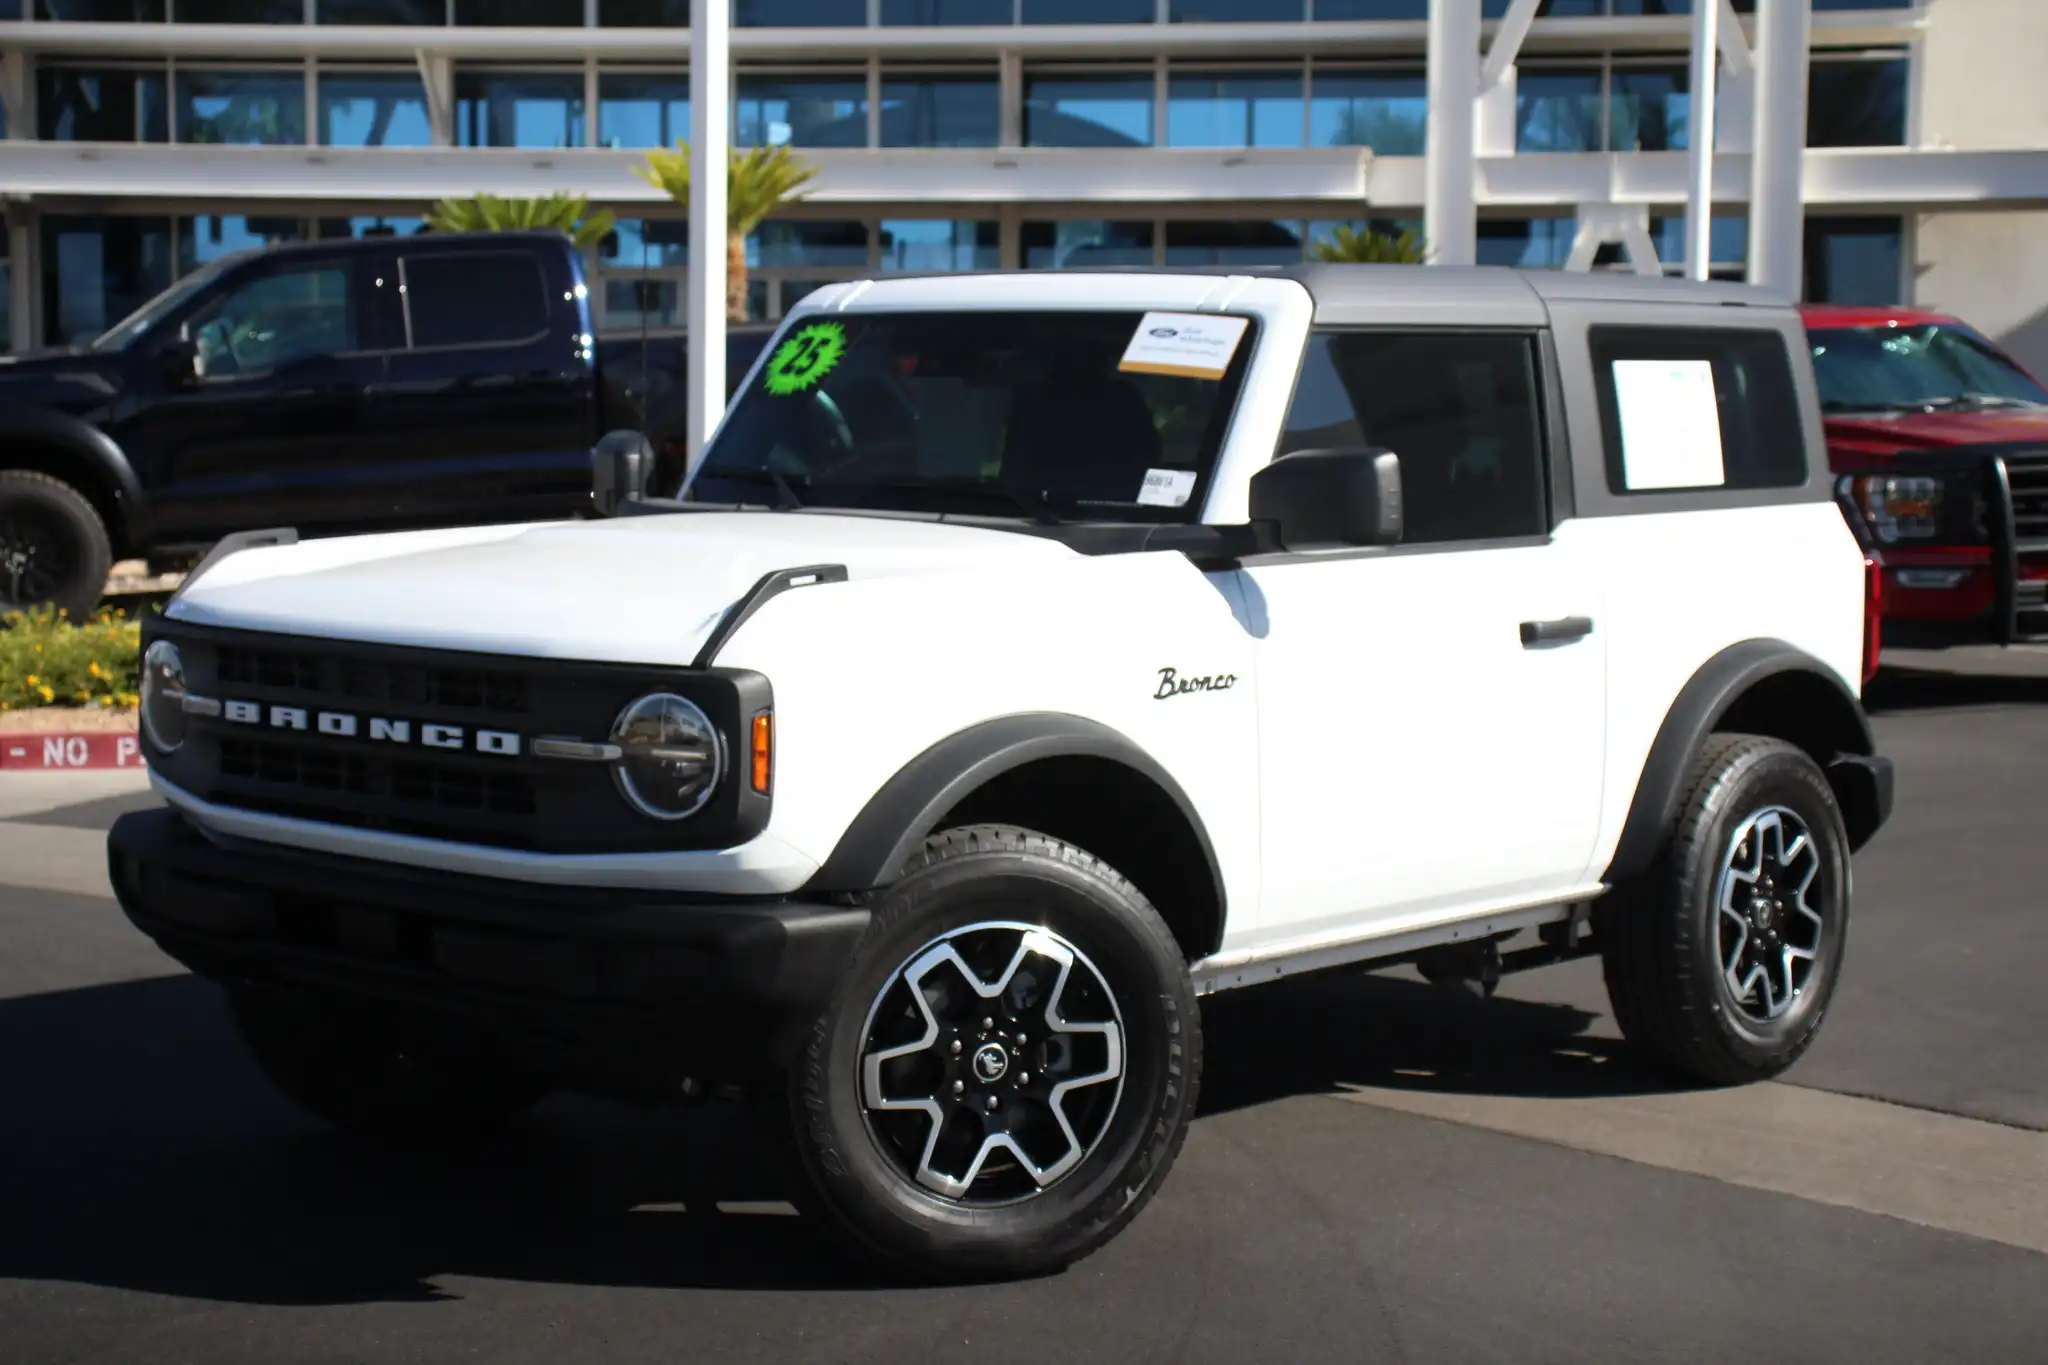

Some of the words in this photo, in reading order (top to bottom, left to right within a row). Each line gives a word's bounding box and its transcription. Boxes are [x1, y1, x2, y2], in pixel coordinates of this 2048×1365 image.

[779, 336, 831, 375] 25
[1153, 667, 1237, 700] Bronco
[224, 700, 520, 755] BRONCO
[43, 736, 89, 767] NO
[117, 737, 147, 766] P
